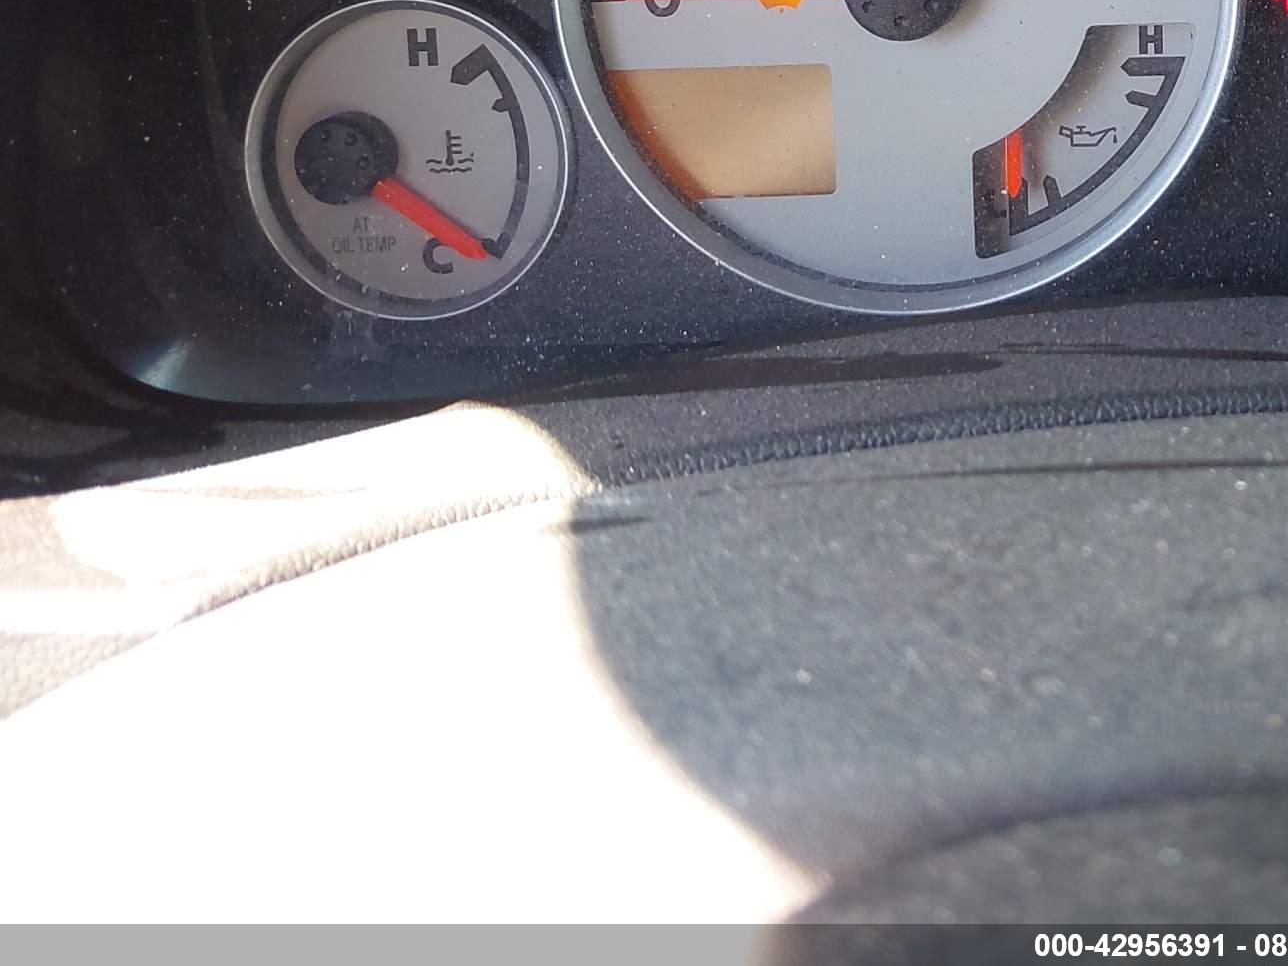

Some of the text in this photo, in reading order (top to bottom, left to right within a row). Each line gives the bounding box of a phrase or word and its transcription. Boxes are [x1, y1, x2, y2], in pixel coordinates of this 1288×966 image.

[407, 28, 438, 66] H
[1139, 25, 1164, 55] H
[353, 216, 370, 233] AT
[332, 235, 397, 254] OIL TEMP
[423, 237, 454, 275] C
